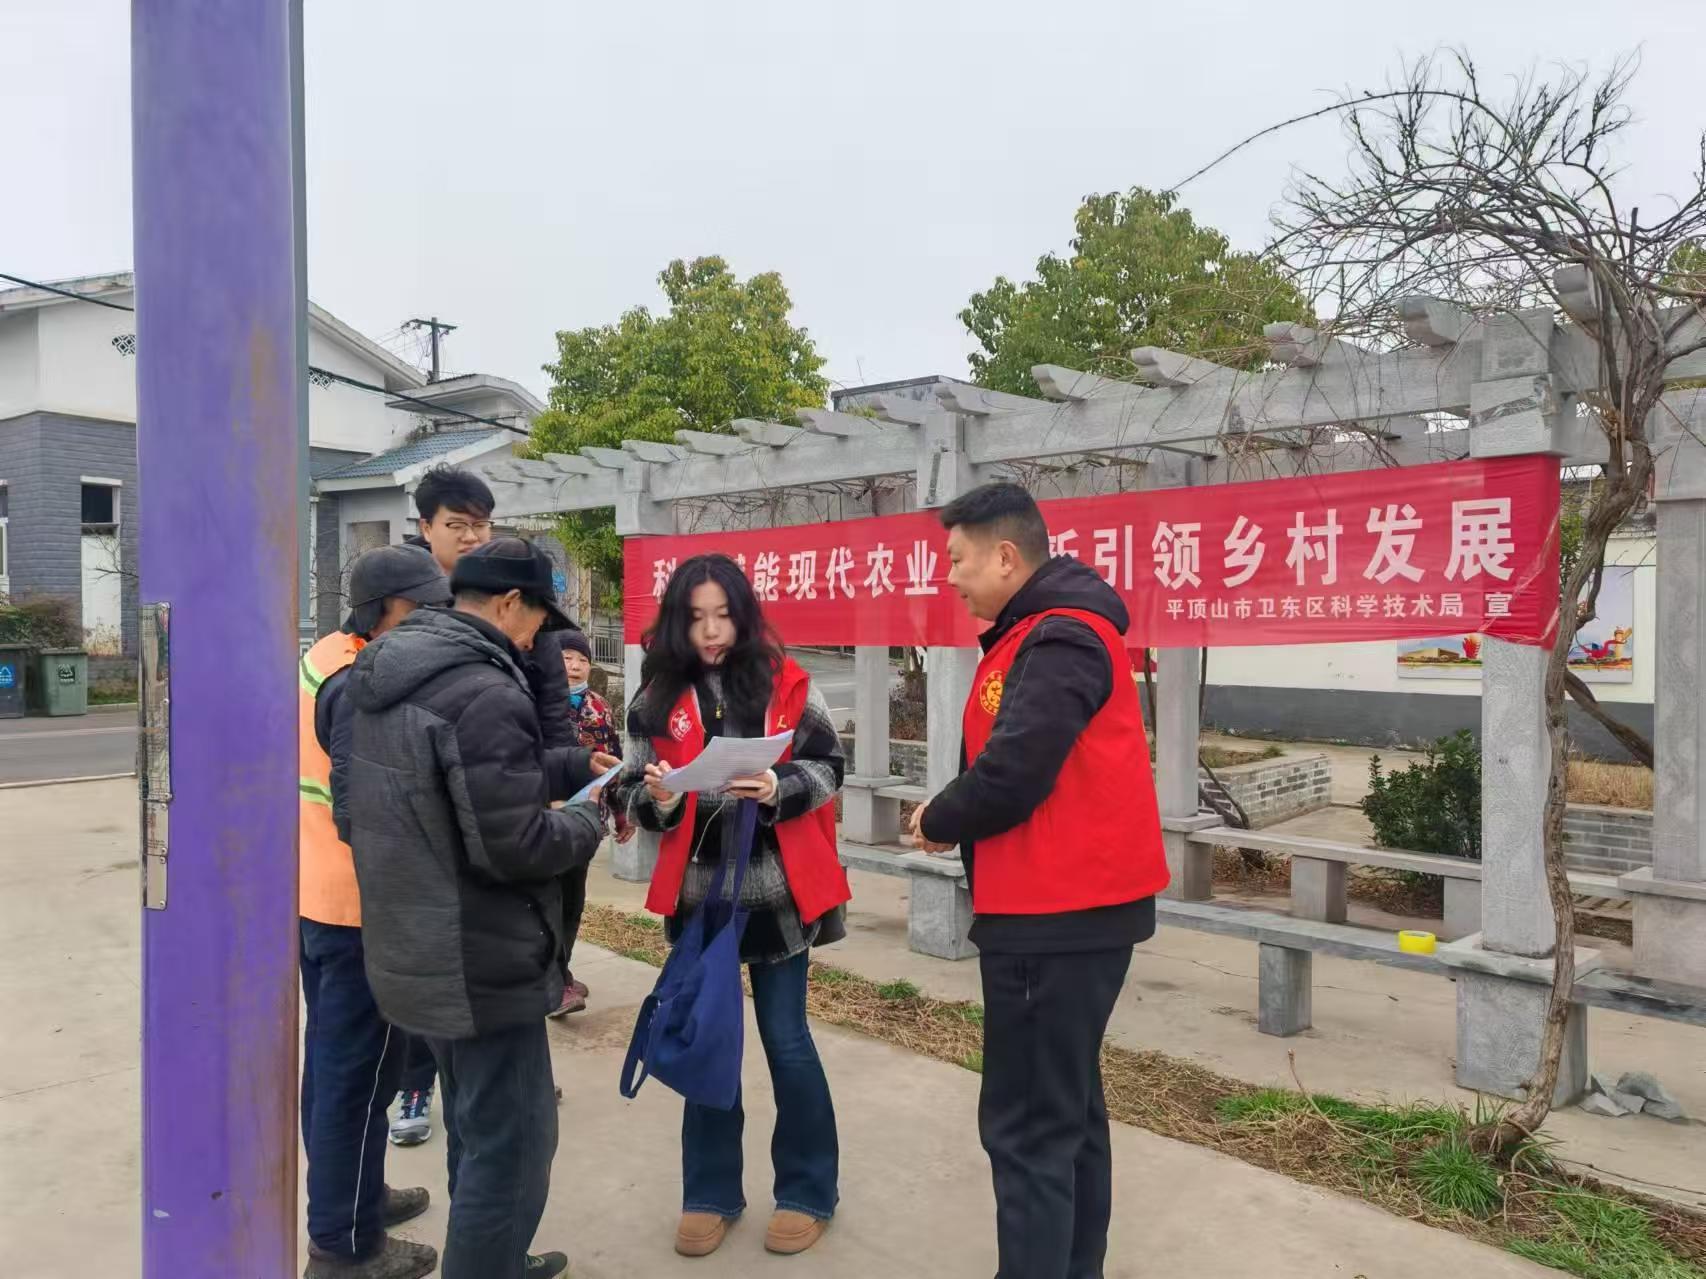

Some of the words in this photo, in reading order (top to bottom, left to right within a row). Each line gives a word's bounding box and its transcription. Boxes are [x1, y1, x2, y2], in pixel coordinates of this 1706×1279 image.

[652, 539, 939, 604] 科能现代农业
[1046, 497, 1515, 591] 引领乡村发展
[1165, 593, 1464, 620] 平顶山市卫东区科学技术局
[1484, 592, 1513, 617] 宣
